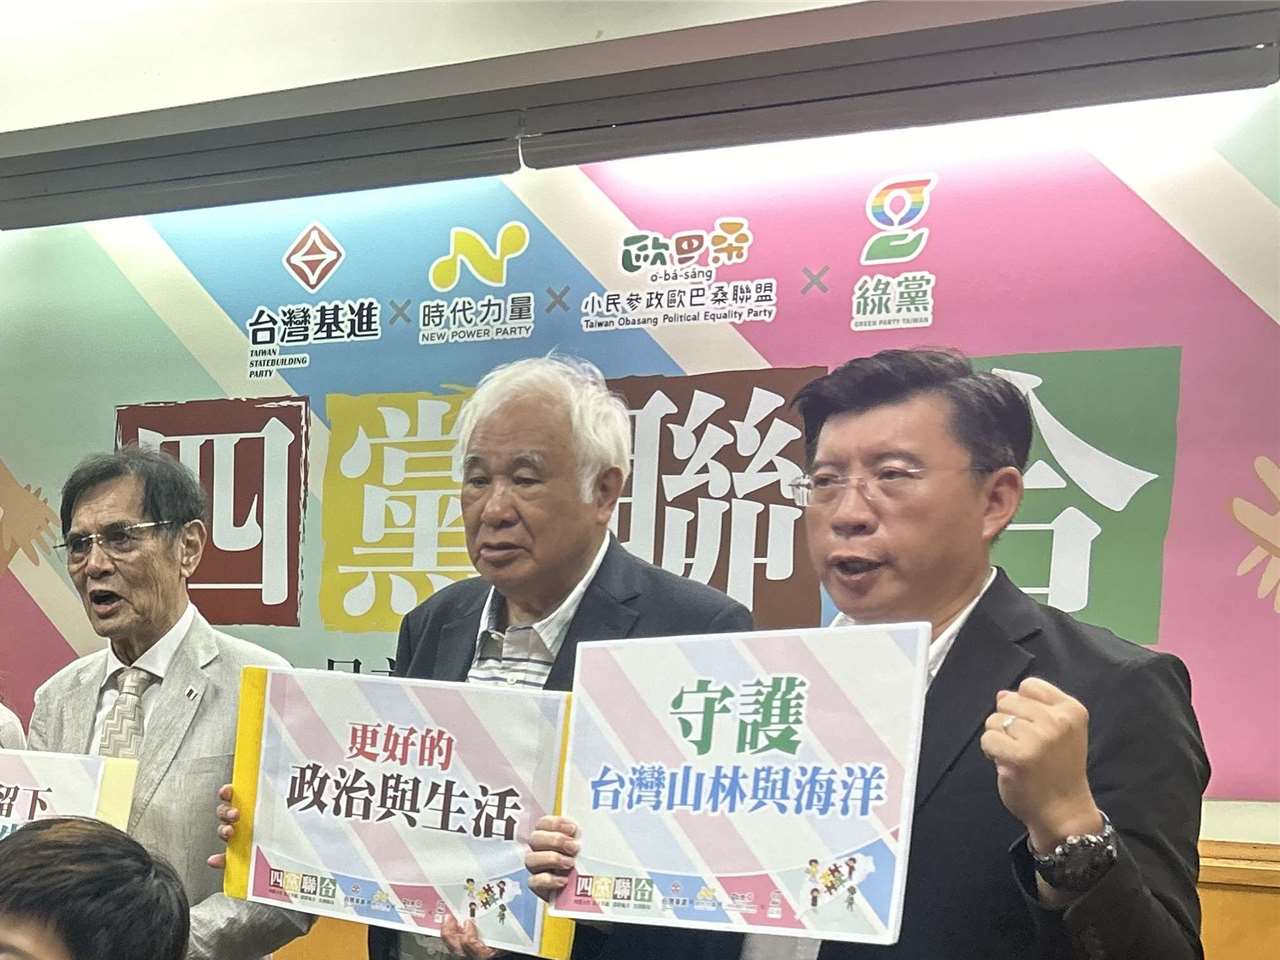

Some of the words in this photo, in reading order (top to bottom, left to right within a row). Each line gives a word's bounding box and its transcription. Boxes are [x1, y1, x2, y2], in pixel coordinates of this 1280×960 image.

[622, 222, 749, 272] 歐巴桑
[422, 296, 532, 327] 時代力量
[584, 282, 774, 313] 小民參政歐巴桑聯盟
[856, 275, 931, 315] 綠黨
[249, 302, 378, 345] 台灣基進
[422, 332, 447, 342] NEW
[451, 329, 490, 339] POWER
[495, 326, 532, 336] PARTY
[584, 319, 615, 329] Taiwan
[618, 315, 658, 327] Obasang
[663, 312, 700, 323] Political
[704, 309, 743, 322] Equality
[747, 307, 774, 319] Party
[249, 357, 308, 367] STATEBUILDING
[250, 349, 277, 357] TAIWAN
[249, 369, 273, 378] PARTY
[670, 677, 807, 756] 守護
[348, 722, 455, 770] 更好的
[287, 764, 521, 841] 政治與生活
[591, 766, 885, 816] 台灣山林與海洋
